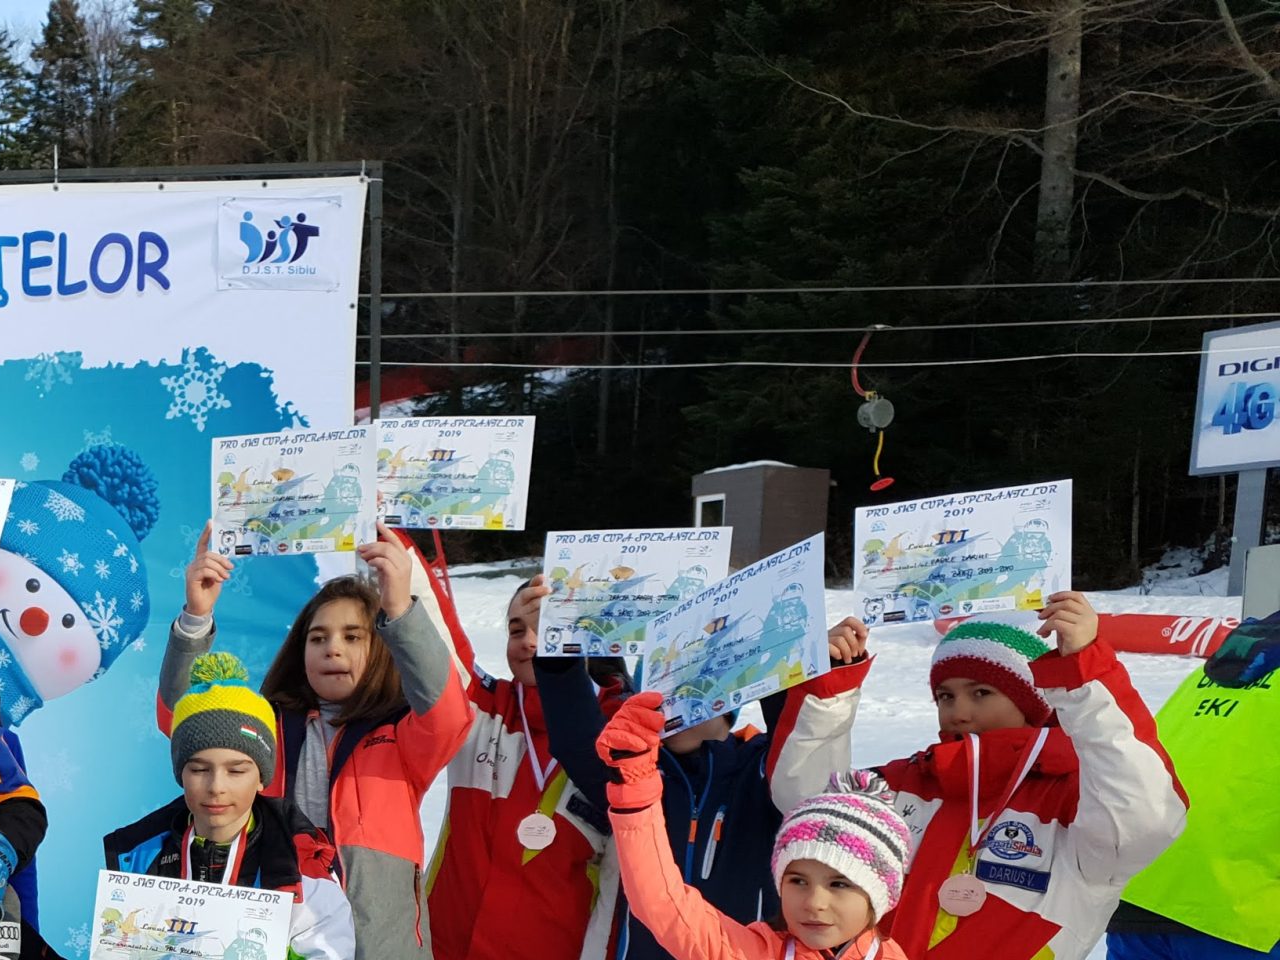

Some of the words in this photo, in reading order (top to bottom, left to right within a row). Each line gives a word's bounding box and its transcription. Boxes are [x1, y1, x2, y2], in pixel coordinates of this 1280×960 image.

[287, 264, 317, 275] Sibiu
[1211, 382, 1276, 435] 4G
[438, 429, 462, 438] 2019
[280, 447, 304, 456] 2019
[430, 449, 455, 462] III
[866, 507, 889, 519] PRO
[943, 507, 974, 518] 2019
[555, 534, 576, 544] PRO
[935, 529, 969, 546] III
[621, 545, 647, 554] 2019
[713, 588, 739, 607] 2019
[654, 612, 672, 628] PRO
[711, 614, 729, 633] II
[108, 874, 129, 885] PRO
[989, 866, 1026, 885] DARIUS
[178, 896, 205, 907] 2019
[167, 918, 198, 935] III
